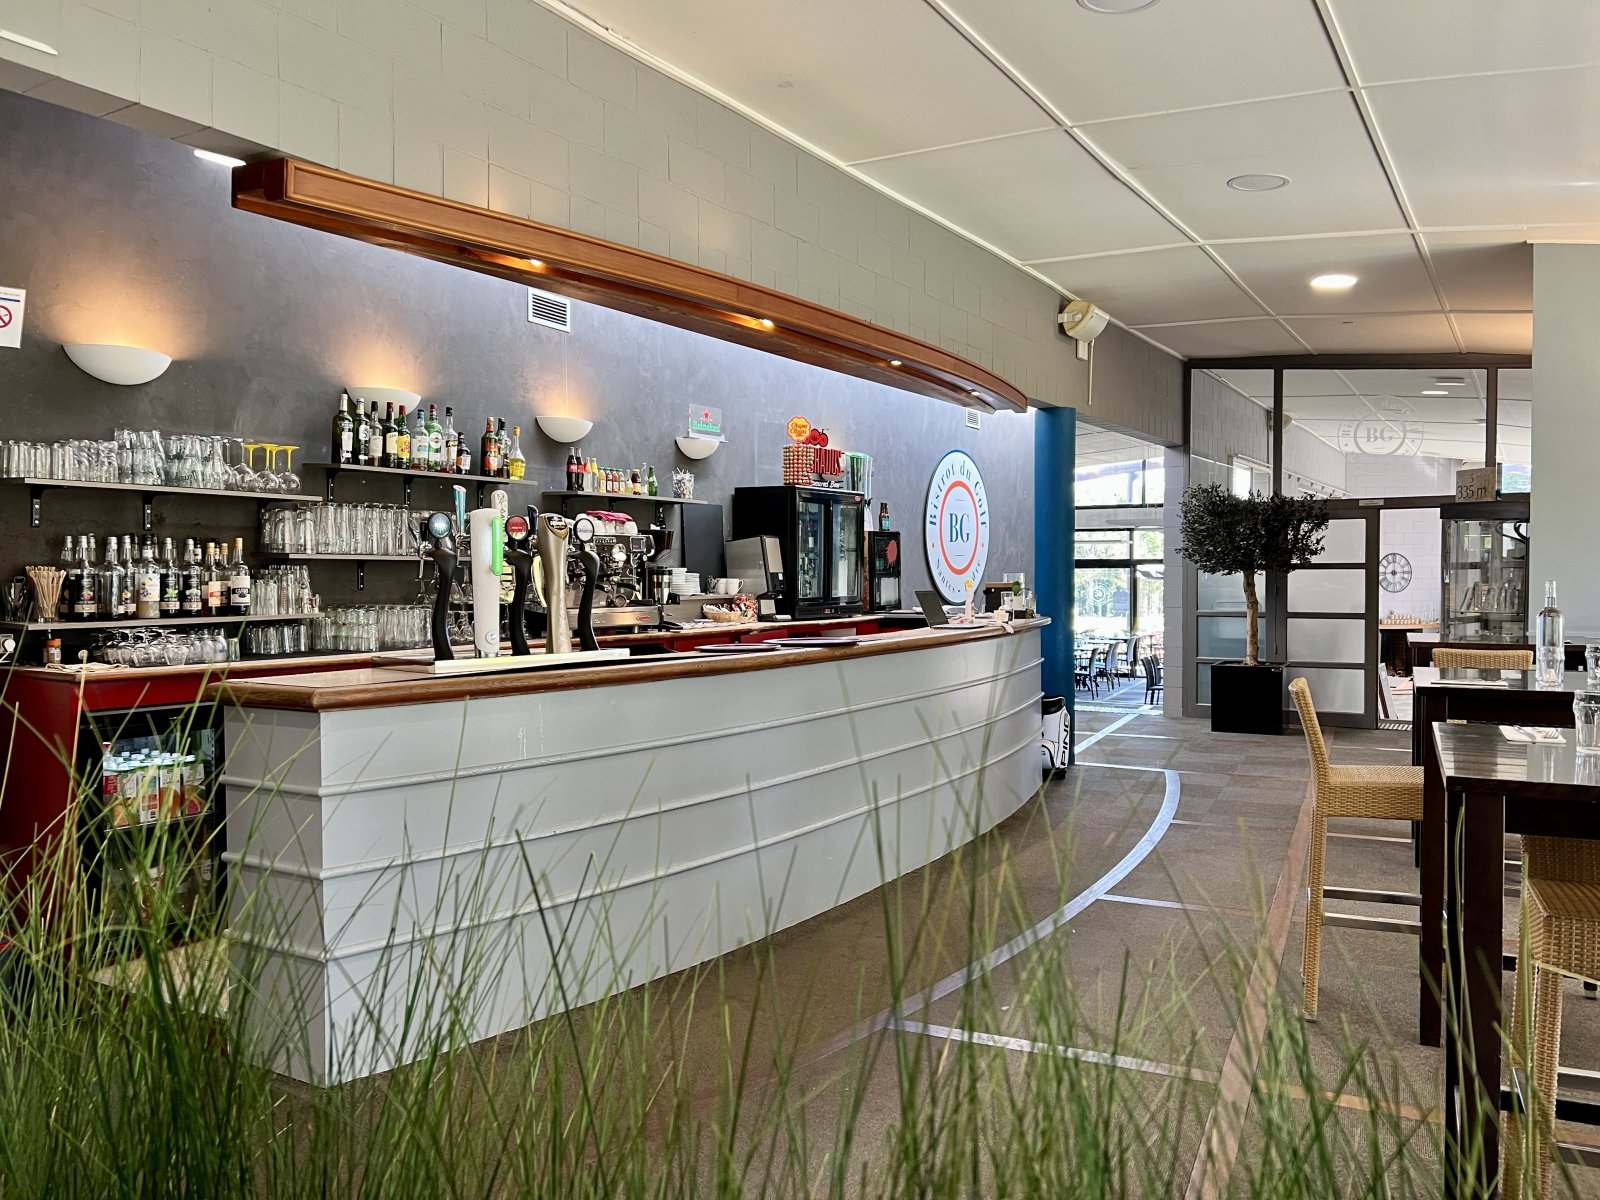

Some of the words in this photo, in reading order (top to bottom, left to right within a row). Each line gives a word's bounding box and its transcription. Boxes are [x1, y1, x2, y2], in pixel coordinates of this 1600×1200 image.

[1366, 426, 1393, 443] BG
[929, 463, 955, 526] Bistrot
[960, 460, 971, 481] du
[974, 481, 988, 529] Golf
[1457, 485, 1474, 499] 335
[1477, 486, 1487, 498] m
[949, 513, 970, 543] BG
[1061, 714, 1070, 766] PING
